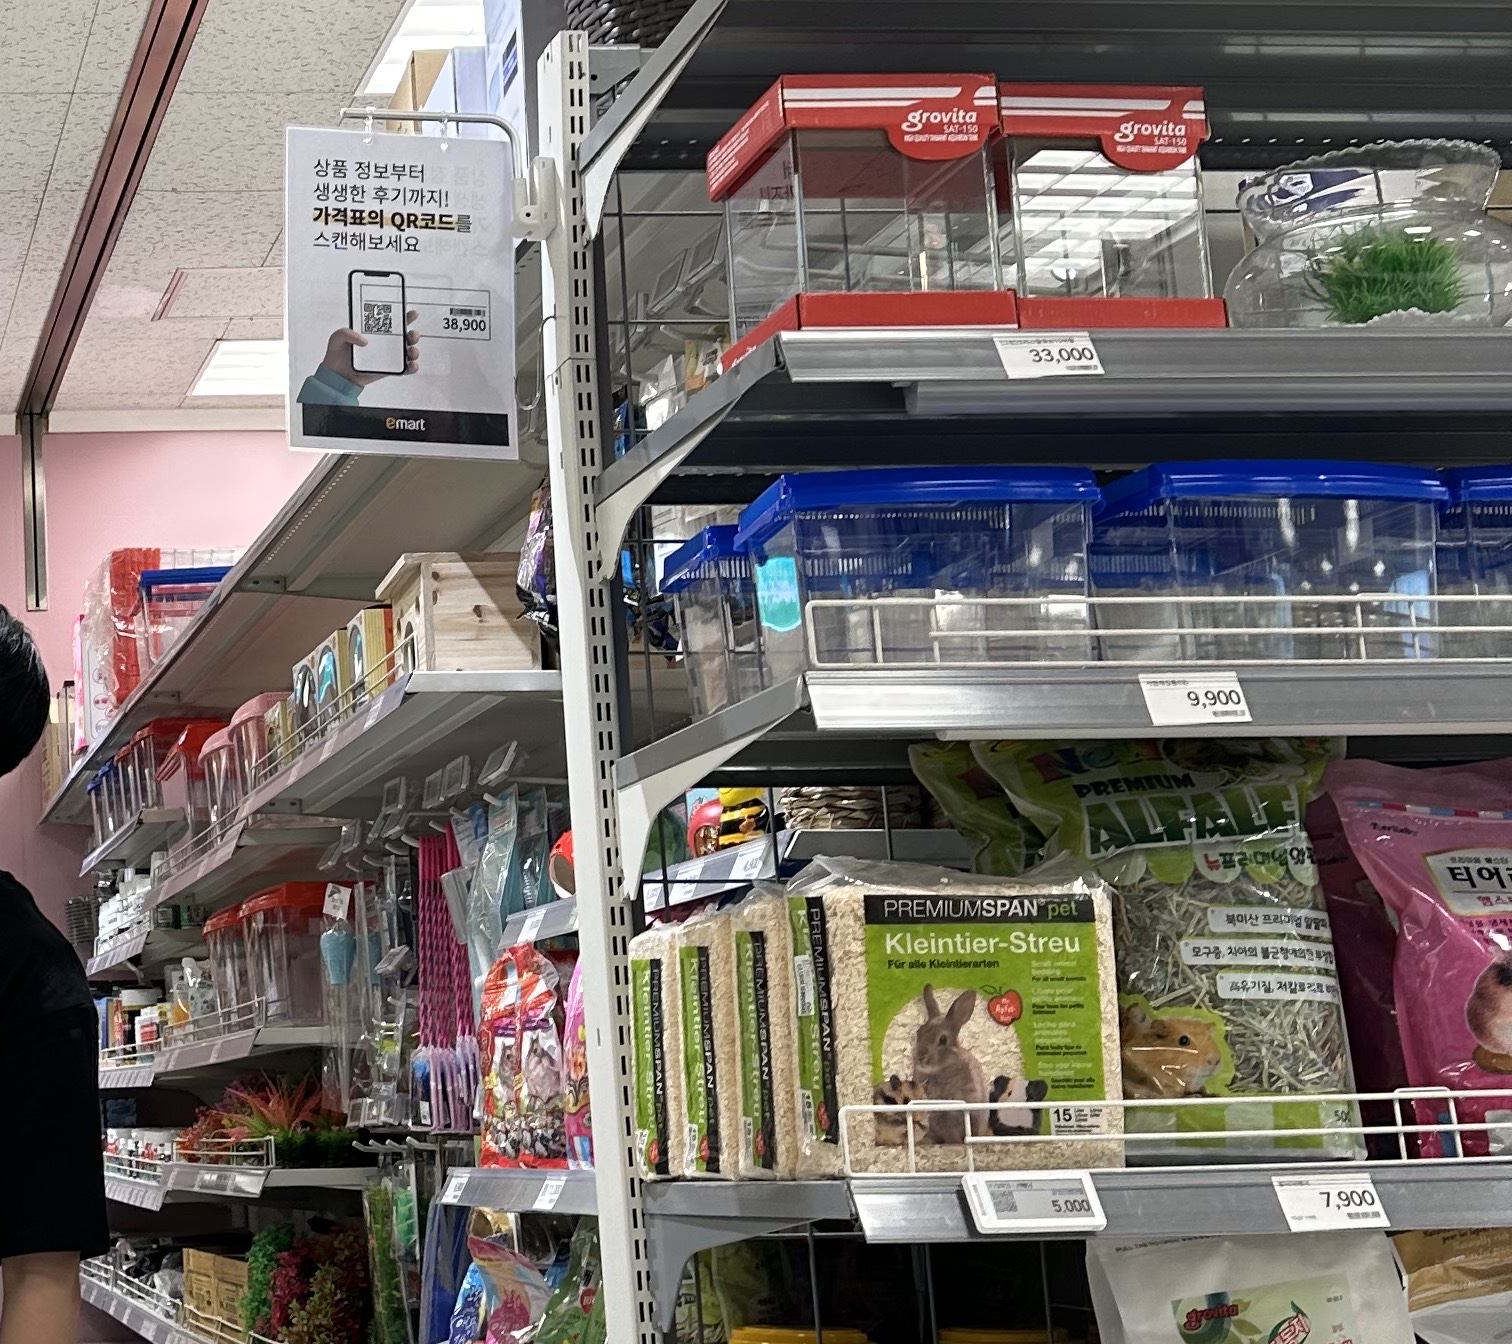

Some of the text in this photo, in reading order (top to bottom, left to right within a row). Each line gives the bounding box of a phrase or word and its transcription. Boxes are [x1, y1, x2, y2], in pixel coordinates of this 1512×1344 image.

[901, 108, 978, 132] grovita
[1114, 120, 1186, 143] grovita
[313, 158, 426, 183] 상품 정보부터
[313, 183, 450, 208] 생생한 후기까지!
[312, 207, 473, 233] 가격표의 QR코드를
[313, 231, 421, 253] 스캔해보세요
[443, 317, 487, 333] 38,900
[1031, 347, 1094, 365] 33,000
[385, 416, 426, 432] emart
[1187, 689, 1241, 709] 9,900
[1072, 773, 1196, 798] PREMIUM
[884, 898, 1079, 920] PREMIUMSPAN pet
[885, 932, 1081, 955] Kleintier-Streu
[887, 958, 906, 969] Für
[908, 959, 926, 969] alle
[810, 907, 831, 1053] PREMIUMSPAN
[1053, 1108, 1073, 1123] 15
[1052, 1198, 1091, 1214] 5,000
[1319, 1189, 1375, 1210] 7,900
[1183, 1304, 1239, 1331] grovita
